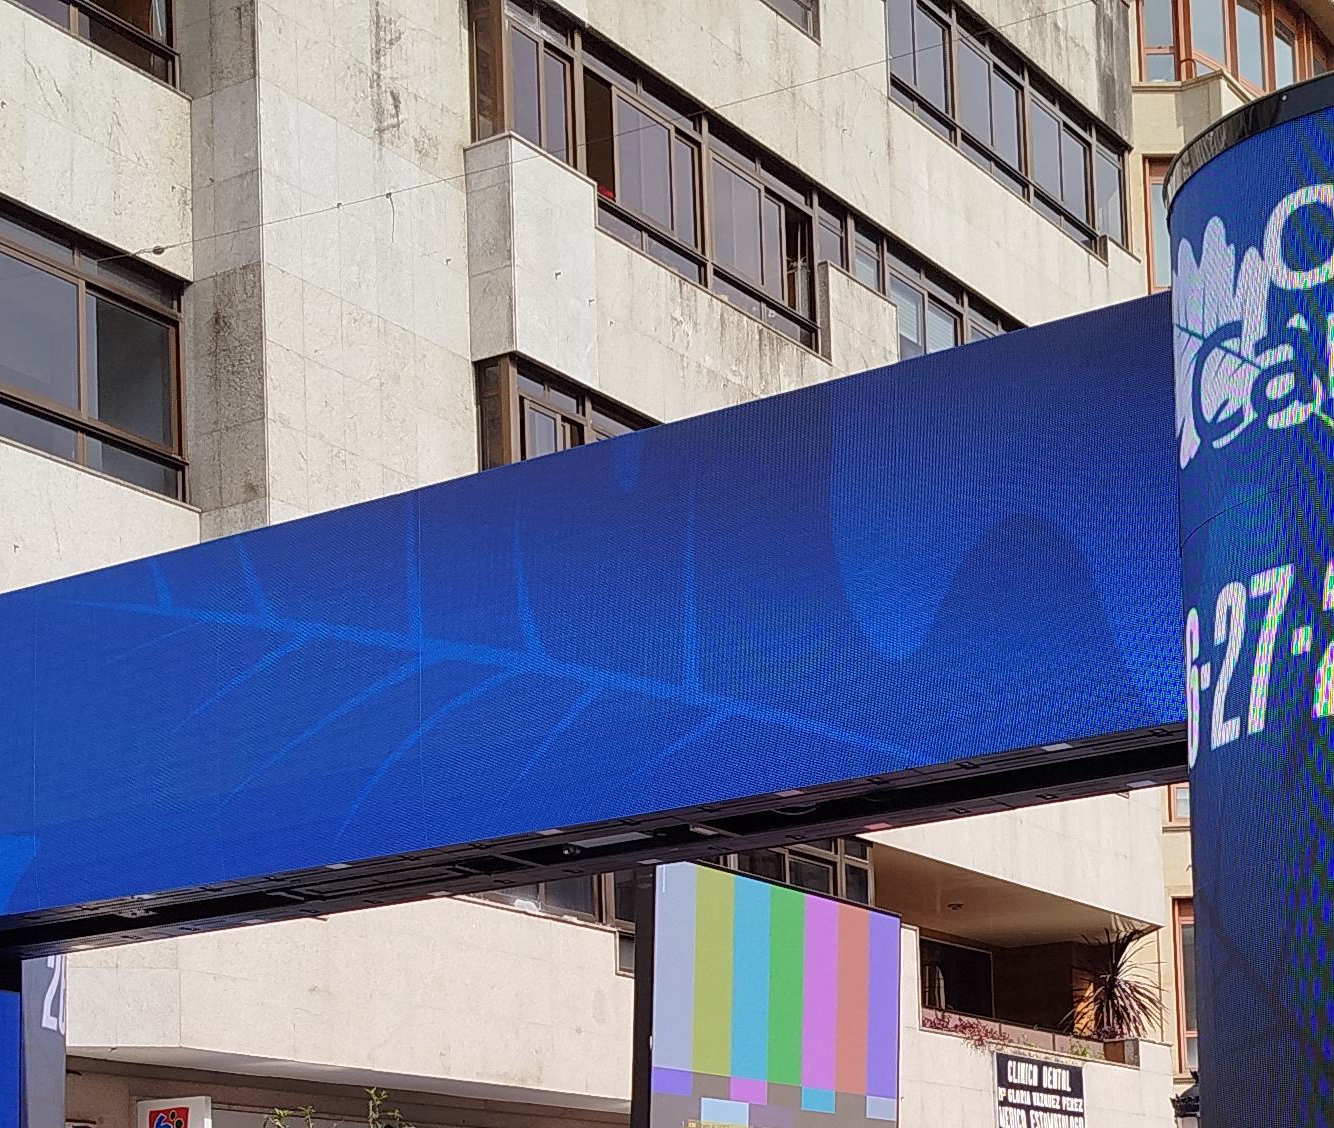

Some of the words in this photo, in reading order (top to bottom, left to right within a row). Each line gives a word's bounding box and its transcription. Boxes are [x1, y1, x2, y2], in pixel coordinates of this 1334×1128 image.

[1007, 1060, 1039, 1087] CLINICA
[1042, 1066, 1071, 1092] DENTAL
[1008, 1088, 1031, 1105] GLORIA
[1062, 1096, 1083, 1112] PEREZ
